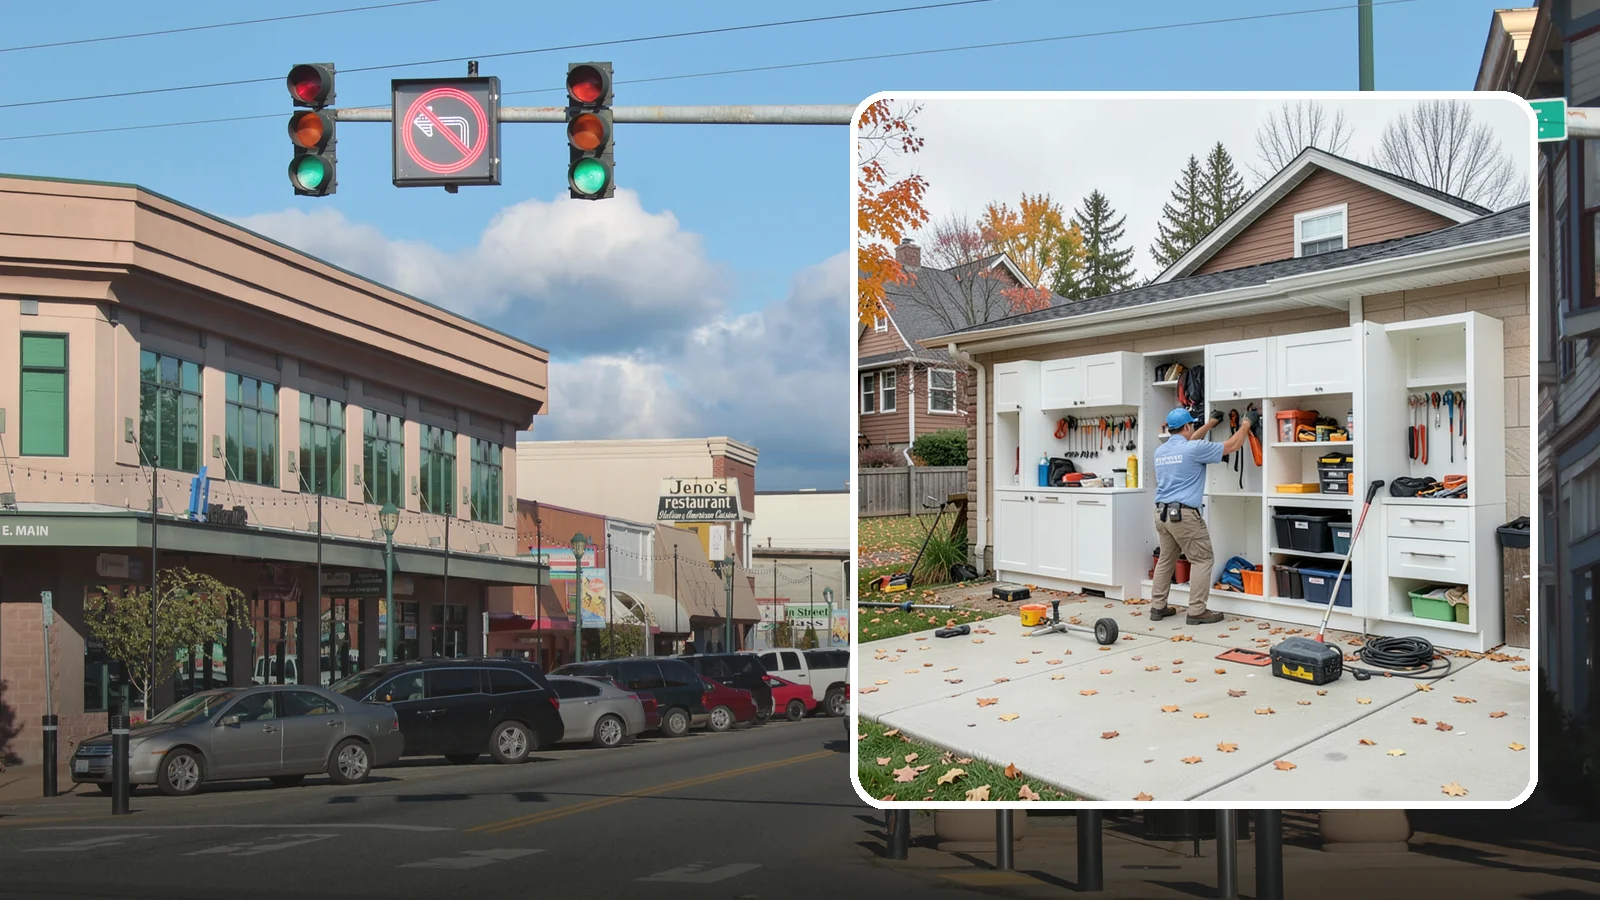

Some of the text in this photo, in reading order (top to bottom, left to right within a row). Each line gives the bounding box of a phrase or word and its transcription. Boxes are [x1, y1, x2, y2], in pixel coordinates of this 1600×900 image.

[670, 480, 727, 494] Jeno's
[665, 497, 731, 509] restaurant
[658, 509, 682, 519] Italian
[686, 509, 715, 519] American
[715, 509, 737, 519] Cuisine
[2, 525, 49, 536] E. MAIN
[797, 607, 828, 617] Street
